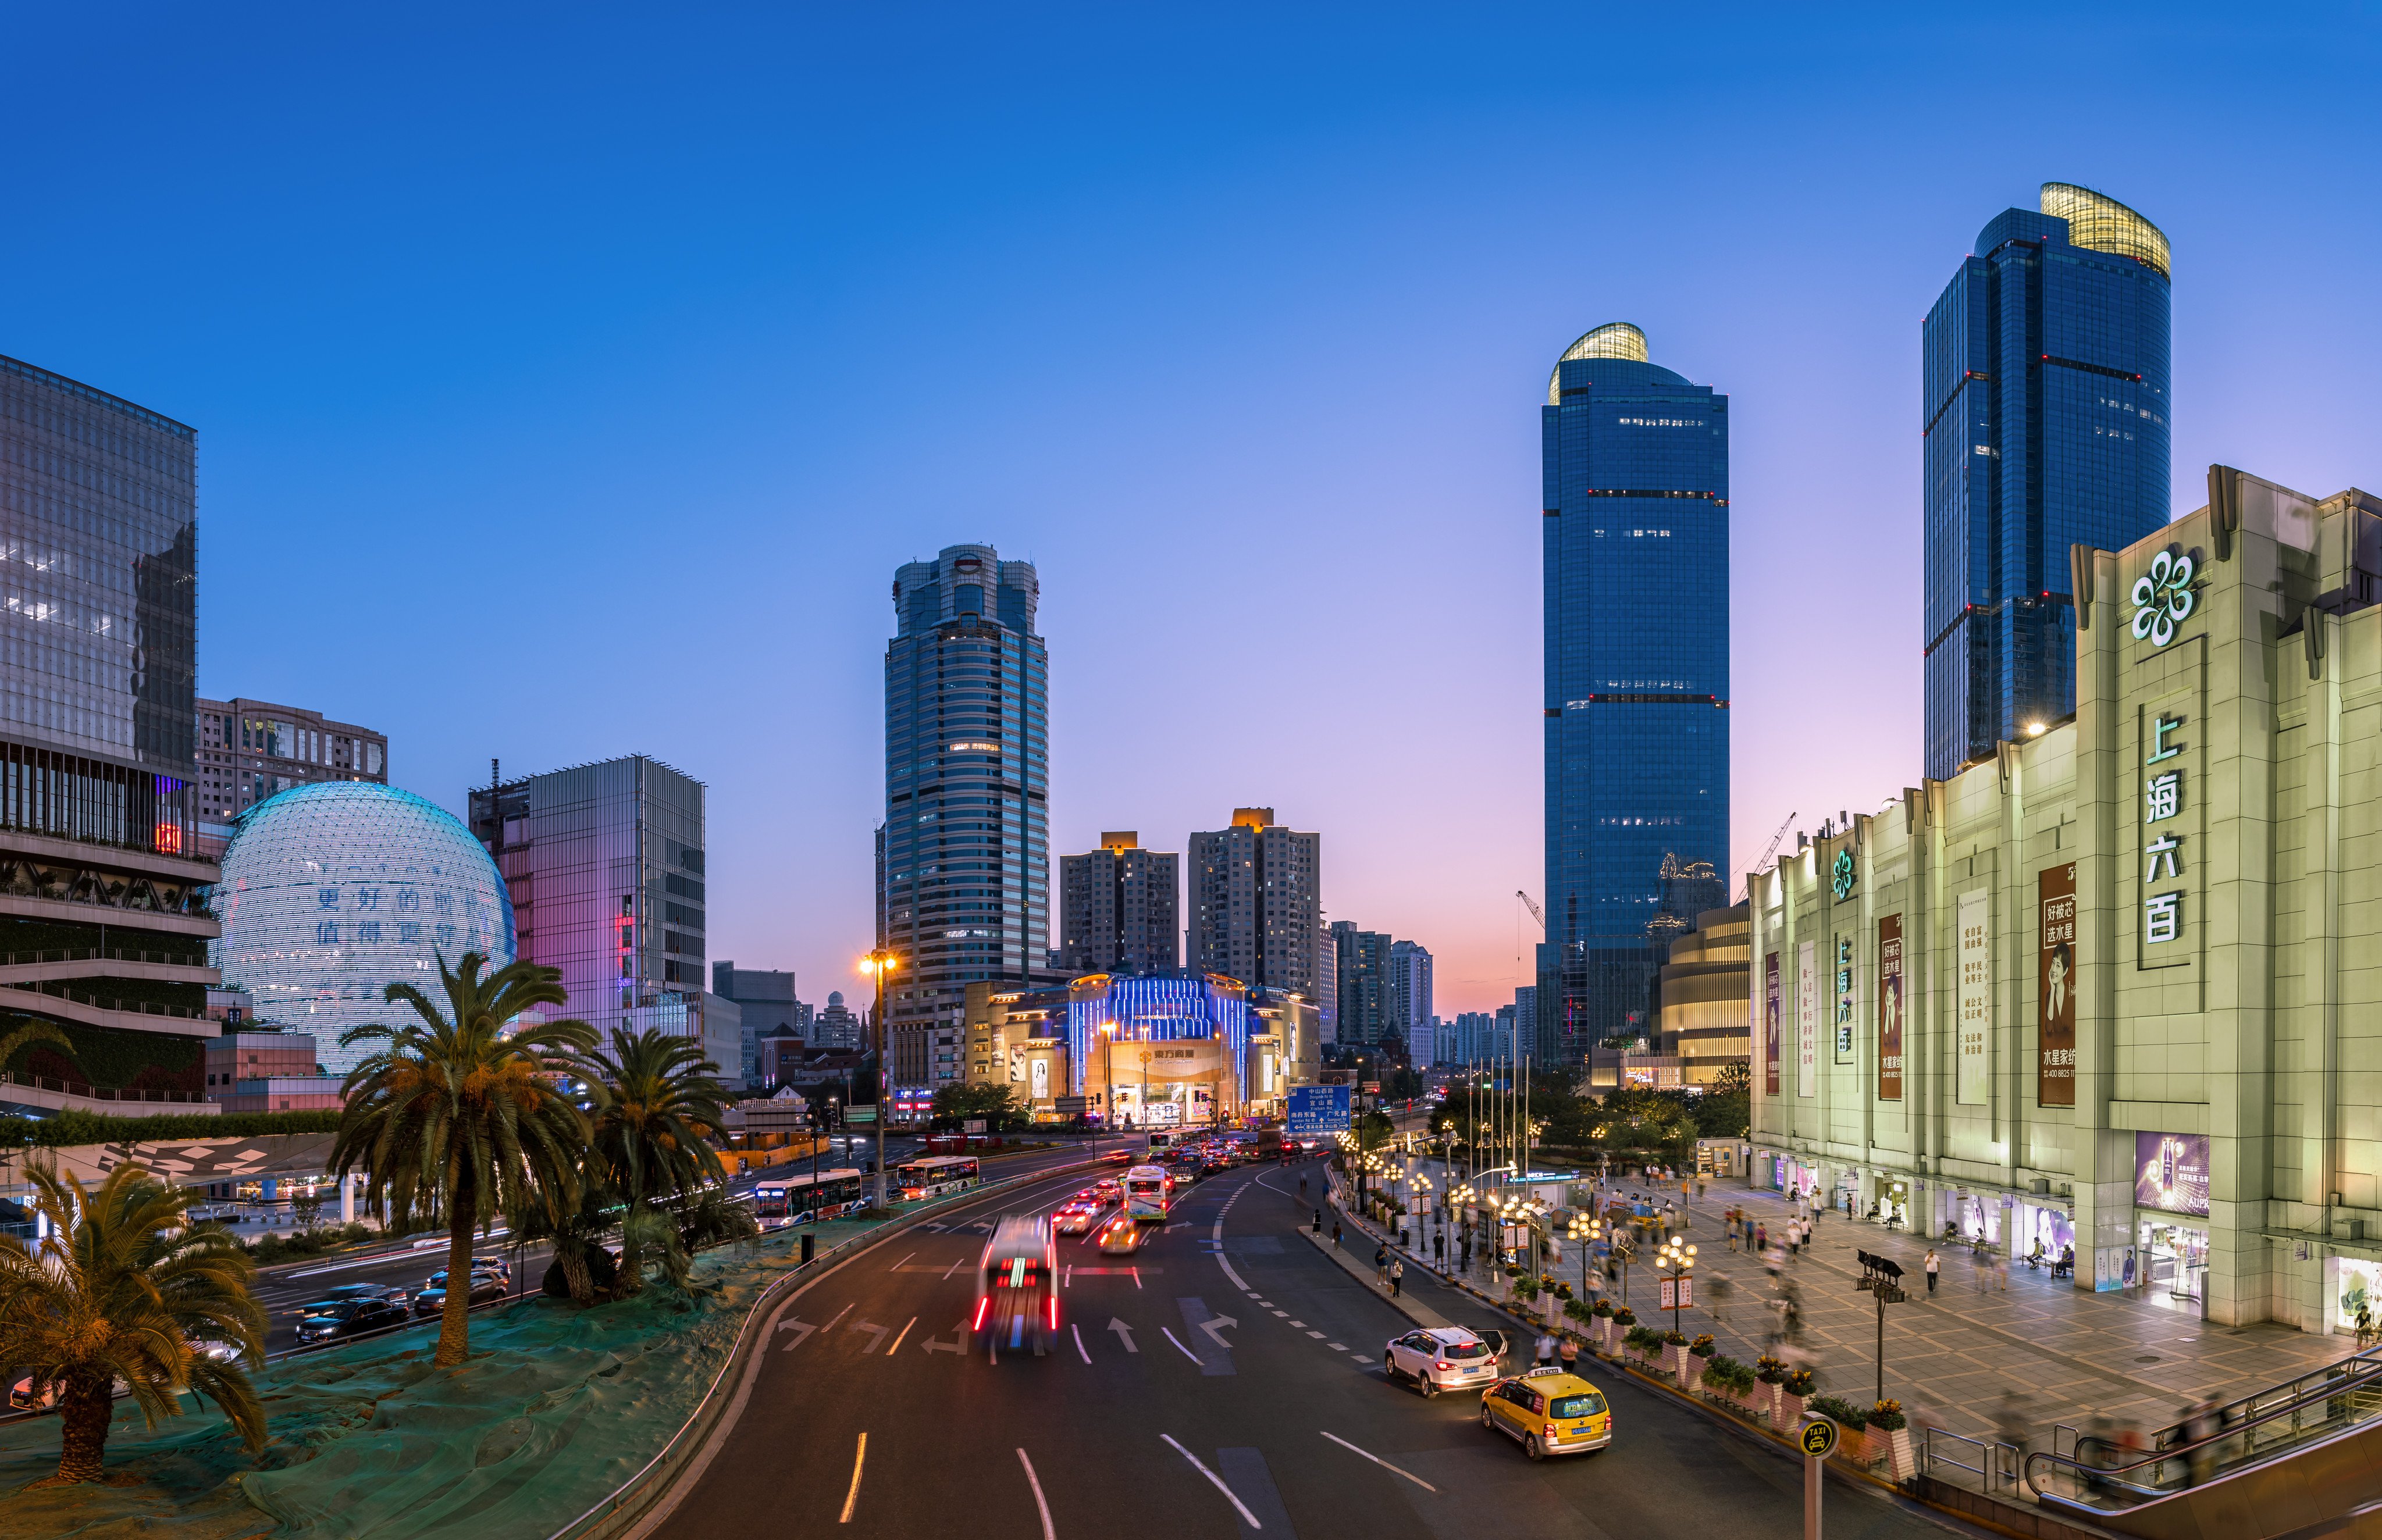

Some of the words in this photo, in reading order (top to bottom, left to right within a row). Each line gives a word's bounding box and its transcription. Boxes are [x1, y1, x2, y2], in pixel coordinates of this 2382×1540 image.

[2146, 717, 2180, 944] 上海六百
[2047, 901, 2073, 921] 好被芯
[1965, 928, 1970, 950] 爱国
[1971, 927, 1976, 949] 自由
[1977, 925, 1982, 947] 富强
[2047, 922, 2073, 942] 选水星
[1884, 943, 1900, 958] 好被芯
[1884, 960, 1900, 974] 选水星
[1965, 963, 1970, 985] 敬业
[1971, 962, 1976, 984] 平等
[1977, 961, 1982, 983] 民主
[1838, 942, 1847, 1052] 上海六百
[1971, 997, 1976, 1019] 公正
[1977, 996, 1982, 1018] 文明
[1965, 998, 1970, 1020] 诚信
[1965, 1033, 1970, 1055] 友善
[1971, 1033, 1976, 1054] 法治
[1977, 1032, 1982, 1054] 和谐
[2043, 1048, 2075, 1066] 水星家纺
[2049, 1070, 2057, 1078] 400
[2058, 1070, 2070, 1078] 8825
[1565, 1434, 1598, 1442] www.62580000.com
[1809, 1427, 1826, 1436] TAXI
